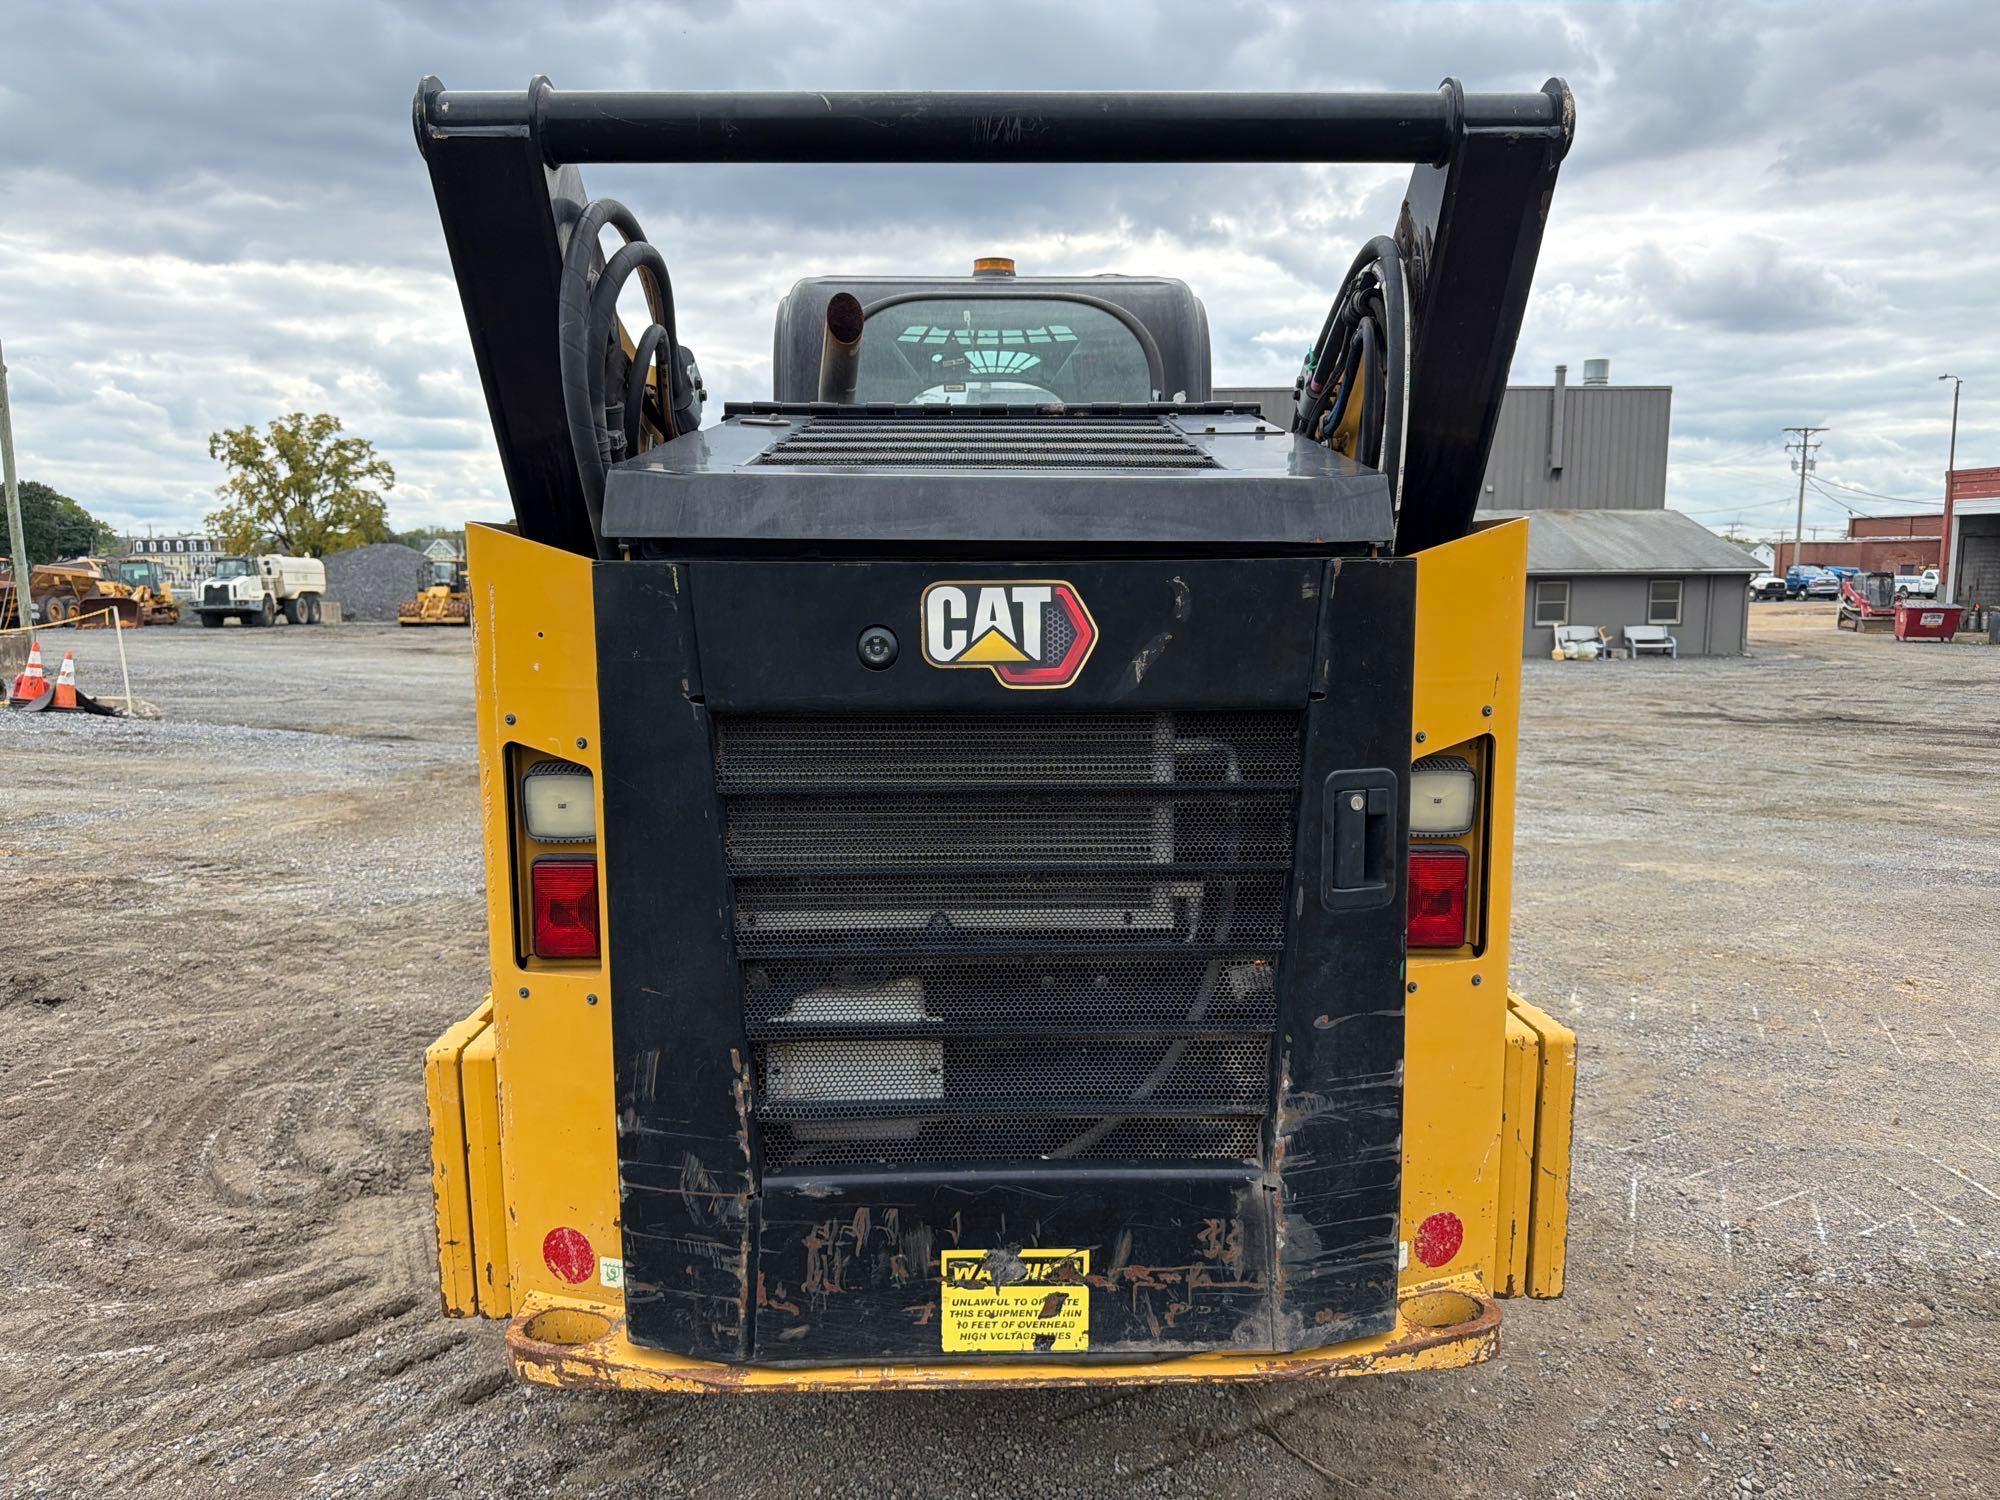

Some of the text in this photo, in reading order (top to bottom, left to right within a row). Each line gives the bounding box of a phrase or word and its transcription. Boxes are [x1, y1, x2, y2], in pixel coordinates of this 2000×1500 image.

[927, 586, 1052, 663] CAT
[952, 1298, 1010, 1306] UNLAWFUL
[1014, 1298, 1028, 1306] TO
[949, 1310, 974, 1318] THIS
[977, 1310, 1040, 1318] EQUIPMENT
[957, 1320, 1076, 1329] 10 FEET OF OVERHEAD
[959, 1331, 986, 1340] HIGH
[990, 1331, 1037, 1340] VOLTAGE
